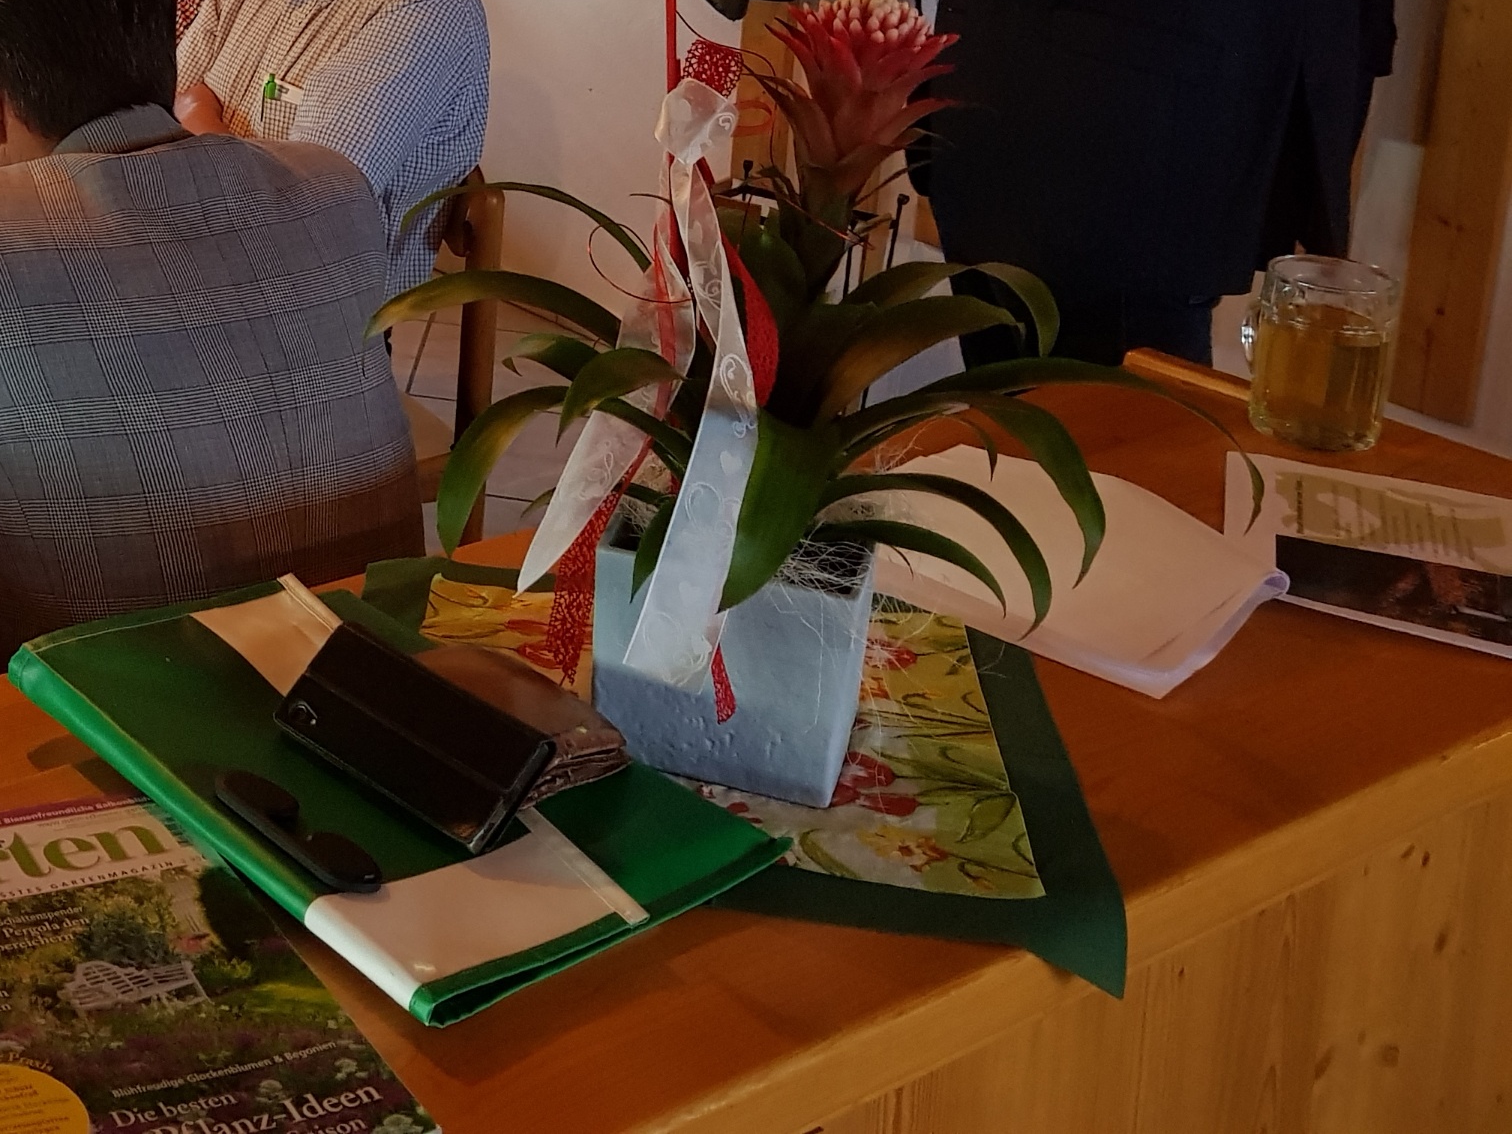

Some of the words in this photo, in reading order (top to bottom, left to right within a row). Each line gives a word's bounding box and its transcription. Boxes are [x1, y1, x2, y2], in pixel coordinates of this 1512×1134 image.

[50, 860, 174, 890] GARTENMAGAZIN
[2, 921, 60, 943] Pergola
[62, 915, 90, 930] den
[112, 1076, 185, 1099] Blühfreudige
[187, 1057, 273, 1083] Glockenblumen
[284, 1040, 337, 1061] Begonien
[109, 1107, 158, 1128] Die
[161, 1091, 238, 1119] besten
